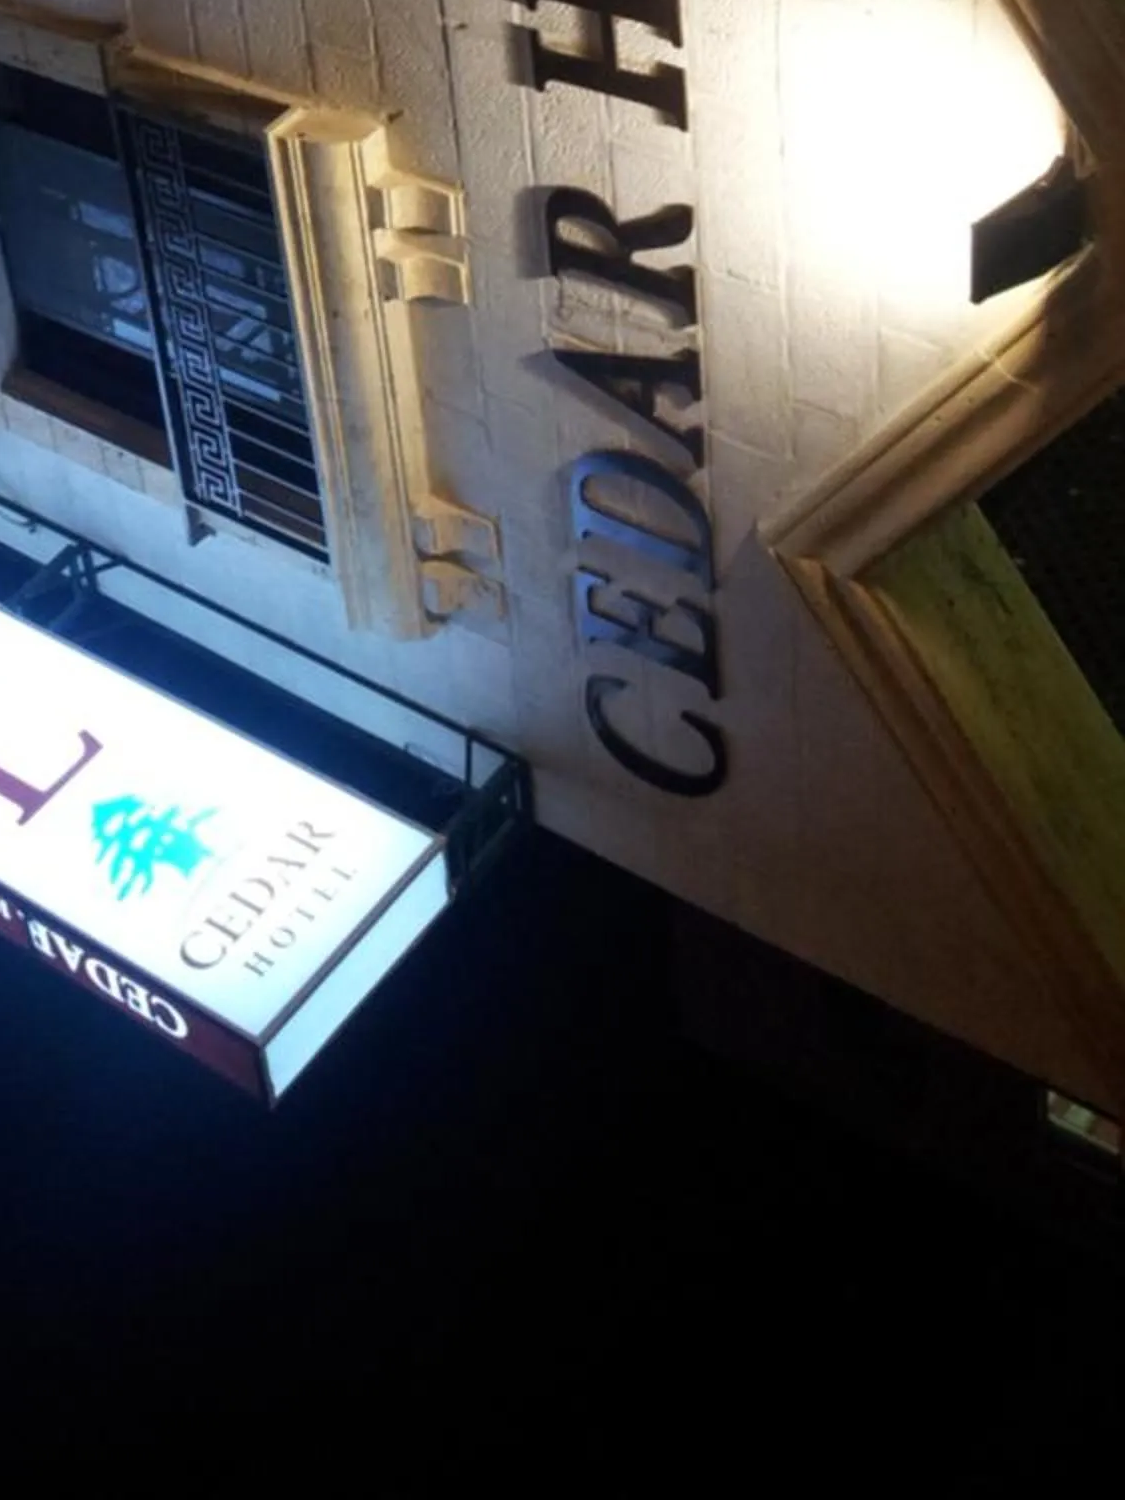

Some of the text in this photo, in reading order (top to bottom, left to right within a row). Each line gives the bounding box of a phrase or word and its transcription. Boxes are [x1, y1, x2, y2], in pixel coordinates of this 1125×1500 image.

[547, 186, 728, 798] CEDAR
[179, 820, 337, 970] CEDAR
[243, 865, 359, 978] HOTEL
